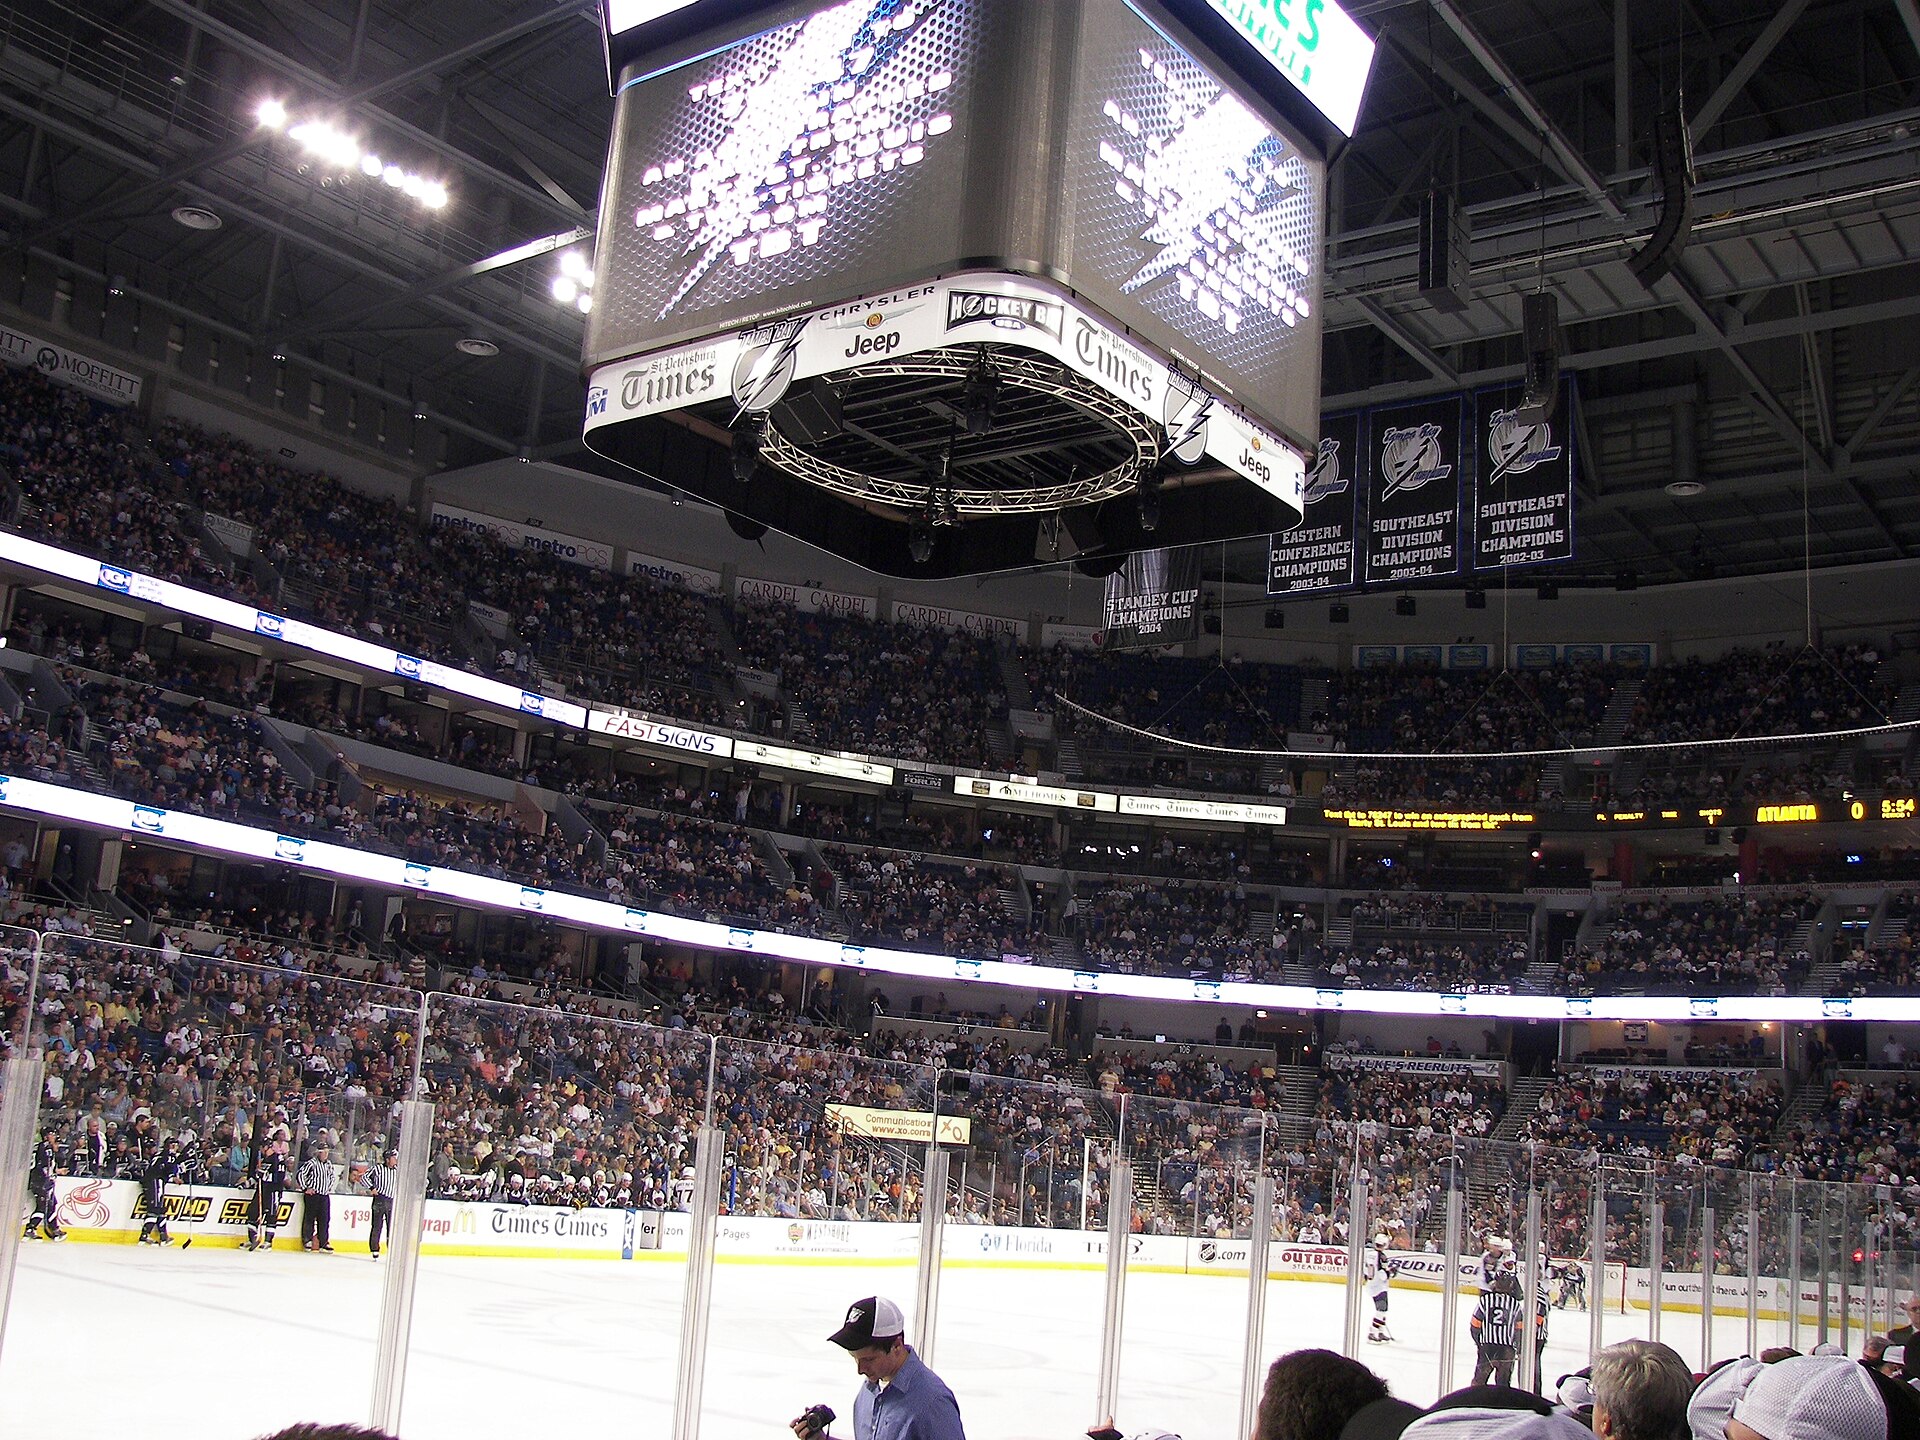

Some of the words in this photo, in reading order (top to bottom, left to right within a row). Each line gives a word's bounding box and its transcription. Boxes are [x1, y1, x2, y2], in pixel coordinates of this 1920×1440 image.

[1103, 100, 1139, 138] AN
[790, 108, 891, 157] FROM
[764, 156, 822, 186] ST.
[834, 115, 952, 166] LOUIS
[641, 160, 684, 188] AN
[771, 145, 925, 203] TICKETS
[728, 217, 829, 266] TBT
[1204, 245, 1295, 328] TICKETS
[1243, 254, 1310, 318] LOUIS
[819, 286, 936, 321] CHRYSLER
[950, 295, 1032, 323] HOCKEY
[1175, 269, 1242, 335] TBT
[740, 327, 773, 348] TAMPA
[773, 320, 798, 341] BAY
[845, 330, 901, 358] Jeep
[664, 348, 717, 373] Petersburg
[1075, 317, 1152, 401] Times
[1111, 336, 1153, 374] Petersburg
[62, 355, 139, 394] MOFFITT
[621, 363, 716, 410] Times
[1170, 368, 1193, 398] TAMPA
[1192, 384, 1210, 406] BAY
[1223, 404, 1289, 452] CHRYSLER
[1239, 452, 1271, 483] Jeep
[1481, 494, 1566, 518] SOUTHEAST
[1372, 510, 1453, 533] SOUTHEAST
[1491, 514, 1555, 535] DIVISION
[433, 511, 520, 544] metroPCS
[525, 534, 608, 566] metroPCS
[1282, 525, 1342, 544] EASTERN
[1381, 530, 1443, 549] DIVISION
[1481, 529, 1565, 553] CHAMPIONS
[1271, 541, 1351, 562] CONFERENCE
[1371, 545, 1452, 568] CHAMPIONS
[1499, 549, 1545, 564] 2002-03
[632, 560, 712, 592] metroPCS
[1273, 558, 1347, 578] CHAMPIONS
[1390, 565, 1433, 579] 2003-04
[1290, 576, 1330, 590] 2003-04
[740, 580, 800, 603] CARDEL
[810, 590, 869, 615] CARDEL
[1106, 593, 1169, 613] STANLEY
[1172, 590, 1198, 604] CUP
[897, 604, 955, 627] CARDEL
[964, 615, 1021, 637] CARDEL
[1111, 605, 1191, 625] CHAMPIONS
[1138, 623, 1162, 634] 2004
[604, 716, 715, 752] FASTSIGNS
[904, 776, 942, 787] FORUM
[1031, 791, 1067, 802] HOMES
[1127, 798, 1160, 811] Times
[1167, 801, 1200, 814] Times
[1206, 804, 1239, 817] Times
[1245, 807, 1278, 820] Times
[1324, 809, 1342, 818] Text
[1512, 813, 1533, 821] from
[1614, 812, 1644, 821] PENALTY
[1699, 809, 1723, 817] SHOTS
[1757, 805, 1816, 822] ATLANTA
[1851, 802, 1864, 820] 0
[1882, 799, 1915, 813] 5:54
[1387, 818, 1411, 828] Louis
[1461, 820, 1481, 828] from
[1593, 883, 1622, 893] Canon
[1812, 883, 1845, 891] Canon
[958, 1026, 969, 1035] 104
[1359, 1060, 1405, 1070] LUKE'S
[1406, 1061, 1472, 1073] RECRUITS
[872, 1125, 931, 1137] www.xo.com
[492, 1207, 549, 1236] Times
[555, 1211, 608, 1238] Times
[723, 1228, 750, 1240] Pages
[1006, 1234, 1053, 1253] Florida
[1217, 1250, 1246, 1262] .com
[1388, 1258, 1426, 1270] BUD
[1493, 1308, 1505, 1326] 2
